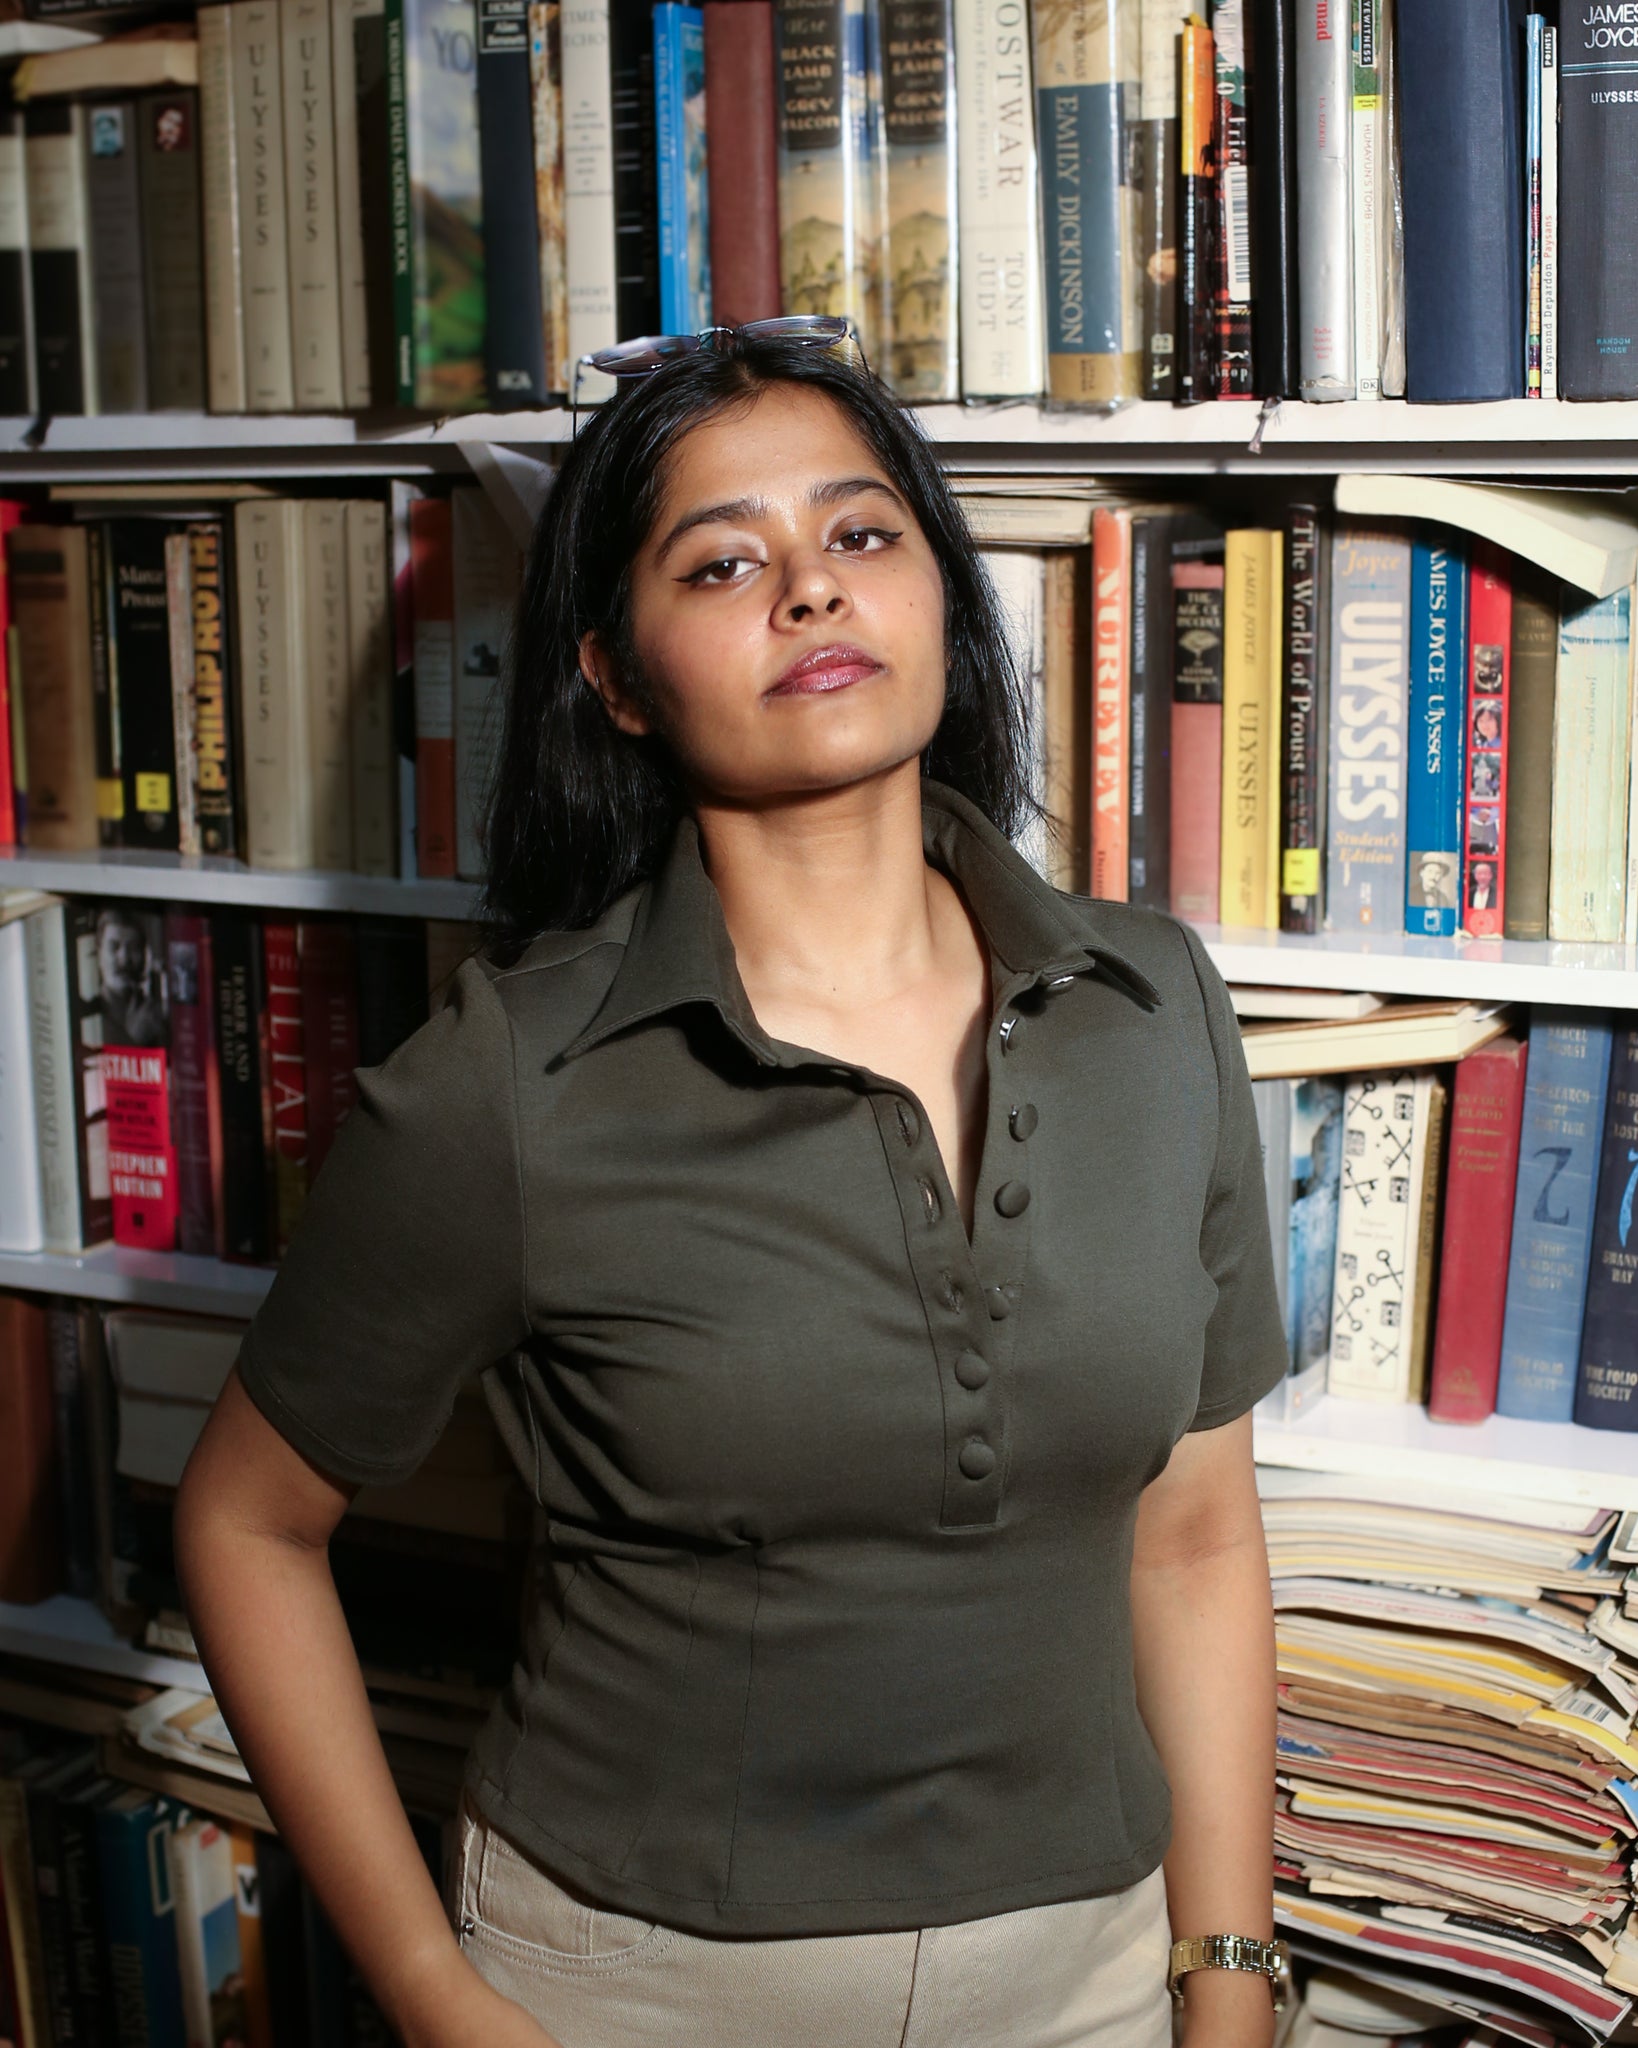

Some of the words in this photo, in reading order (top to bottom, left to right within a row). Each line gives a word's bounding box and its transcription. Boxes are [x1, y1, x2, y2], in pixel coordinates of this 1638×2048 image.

[781, 45, 835, 61] BLACK
[784, 64, 832, 80] LAMB
[889, 39, 945, 55] BLACK
[892, 58, 944, 75] LAMB
[1544, 33, 1552, 66] POINTS
[250, 44, 268, 247] ULYSSES
[301, 37, 317, 243] ULYSSES
[1056, 94, 1080, 185] EMILY
[1364, 124, 1373, 187] HUMAYUN'S
[392, 157, 407, 226] ADDRESS
[1364, 190, 1373, 220] TOMB
[394, 229, 408, 275] BOOK
[1543, 215, 1554, 259] Paysans
[977, 252, 997, 331] JUDT
[1005, 252, 1026, 330] TONY
[1057, 194, 1083, 344] DICKINSON
[1544, 263, 1554, 318] Depardon
[1544, 323, 1554, 375] Raymond
[1362, 380, 1376, 389] DK
[1291, 520, 1315, 569] The
[1342, 549, 1401, 577] Joyce
[190, 534, 222, 651] ROTH
[1244, 555, 1257, 608] JAMES
[1430, 546, 1447, 611] AMES
[254, 543, 270, 722] ULYSSES
[1242, 613, 1256, 665] JOYCE
[1292, 578, 1314, 654] World
[1429, 613, 1447, 683] JOYCE
[1098, 568, 1121, 829] NUREYEV
[1291, 663, 1312, 689] of
[195, 654, 228, 791] PHILIP
[1291, 695, 1312, 769] Proust
[1336, 601, 1402, 822] ULYSSES
[1425, 695, 1447, 774] Ulysses
[1237, 702, 1259, 829] ULYSSES
[1334, 831, 1400, 848] Student's
[1339, 847, 1394, 865] Edition
[104, 1055, 162, 1084] STALIN
[235, 1040, 251, 1083] AND
[38, 1051, 60, 1150] ODYSSEY
[109, 1152, 167, 1176] STEPHEN
[1586, 1365, 1604, 1382] THE
[1606, 1368, 1638, 1387] FOLIO
[1587, 1383, 1632, 1402] SOCIETY
